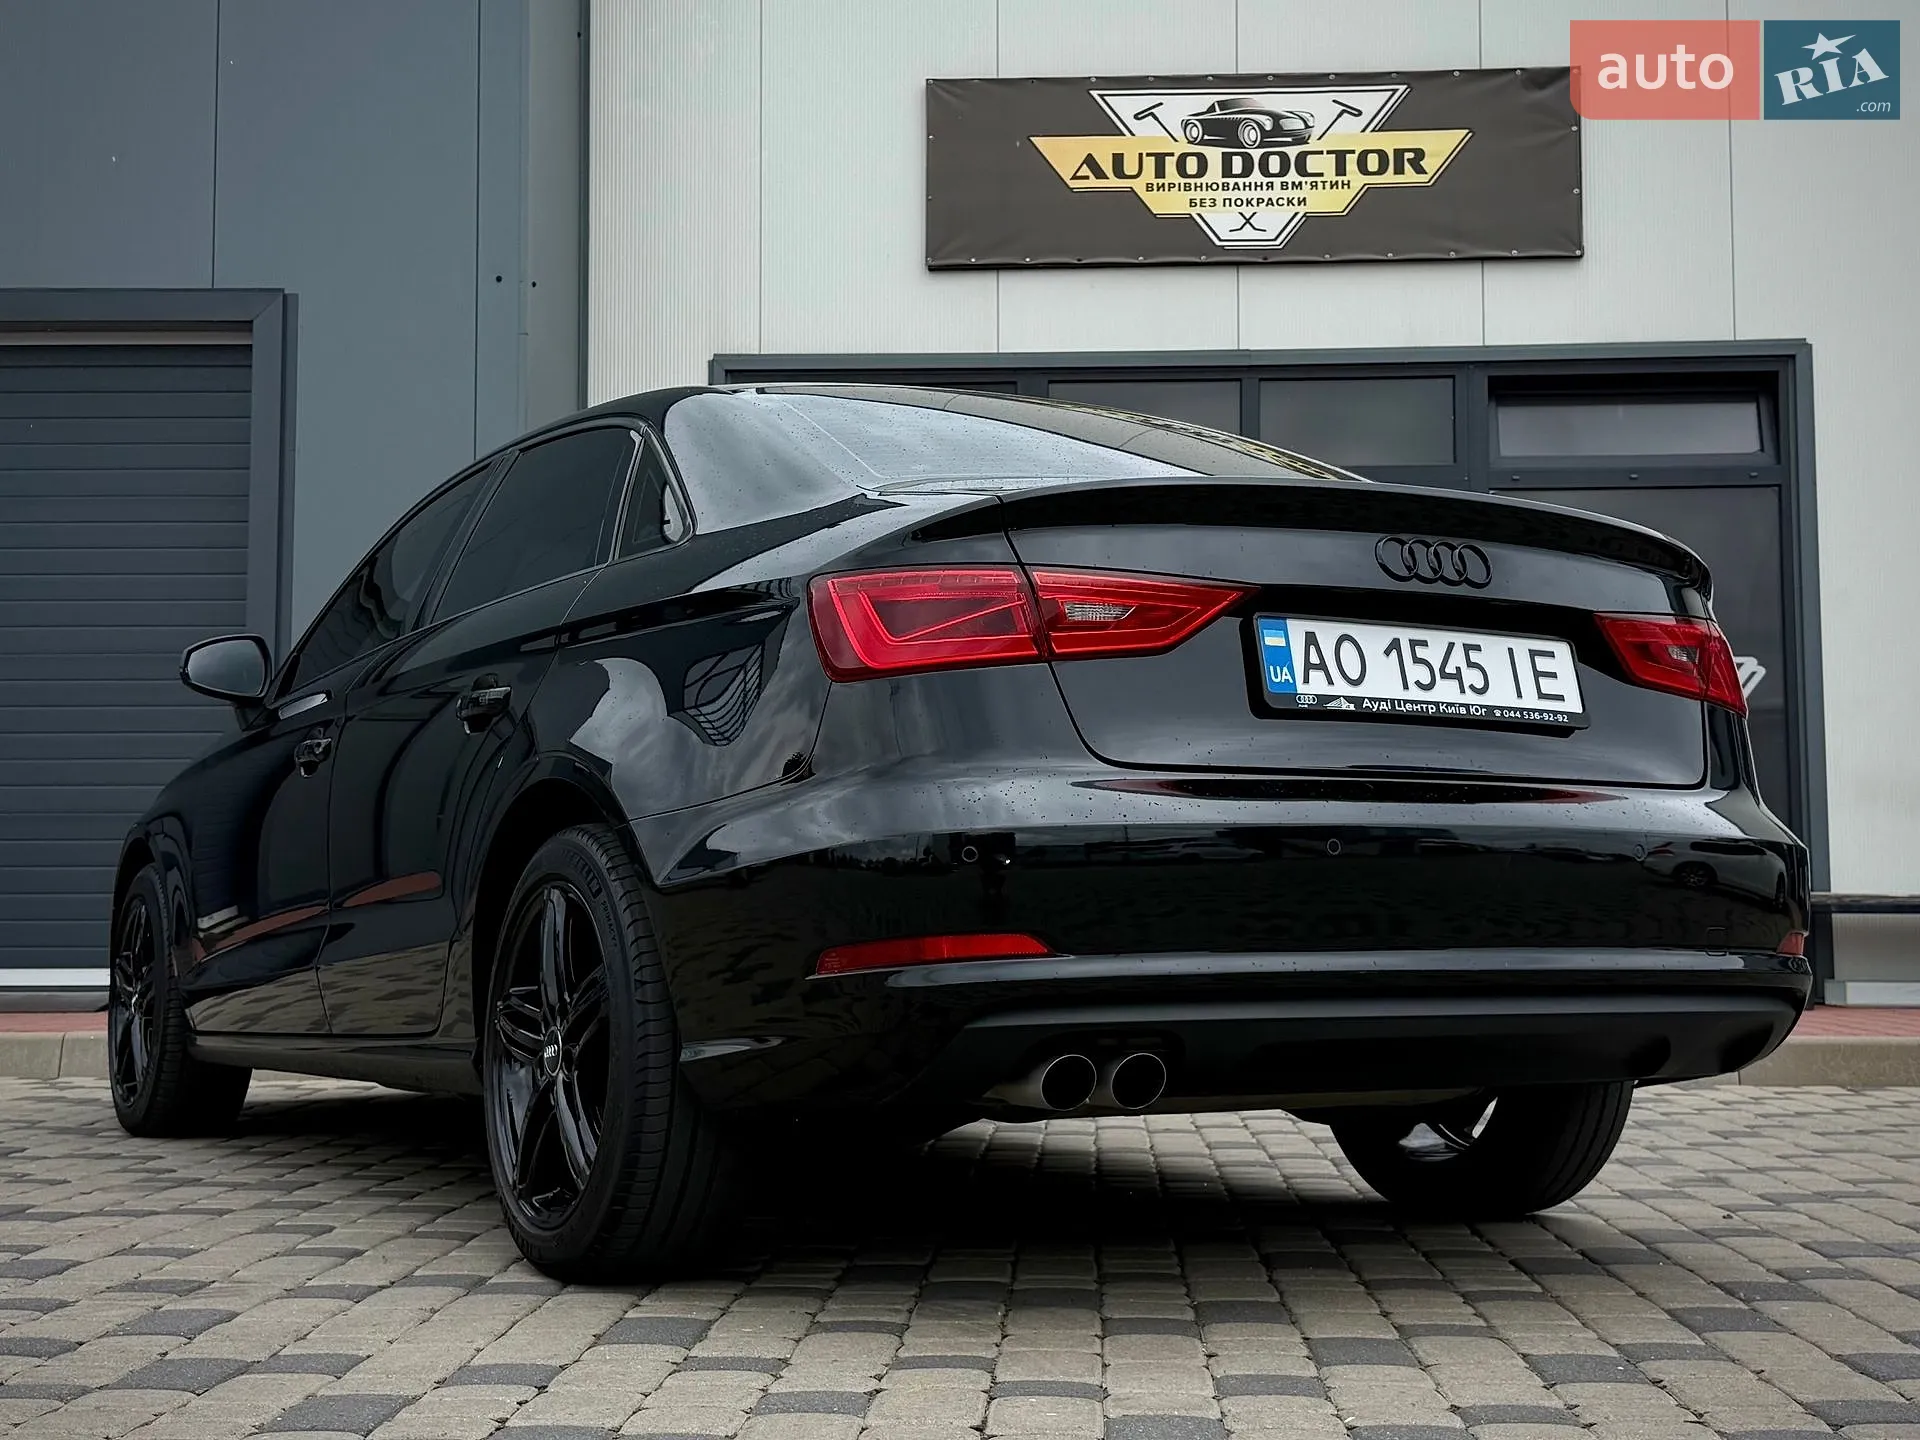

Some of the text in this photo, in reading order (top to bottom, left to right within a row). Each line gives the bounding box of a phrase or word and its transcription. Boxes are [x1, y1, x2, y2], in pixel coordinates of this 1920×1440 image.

[1070, 147, 1427, 180] AUTO DOCTOR
[1146, 180, 1274, 193] ВИРІВНЮВАННЯ
[1189, 196, 1307, 208] БЕЗ ПОКРАСКИ
[1270, 666, 1293, 683] UA
[1302, 631, 1565, 702] AO 1545 IE
[1363, 699, 1487, 716] Ауді Центр Київ Юг
[1503, 709, 1568, 722] 044 536-92-92
